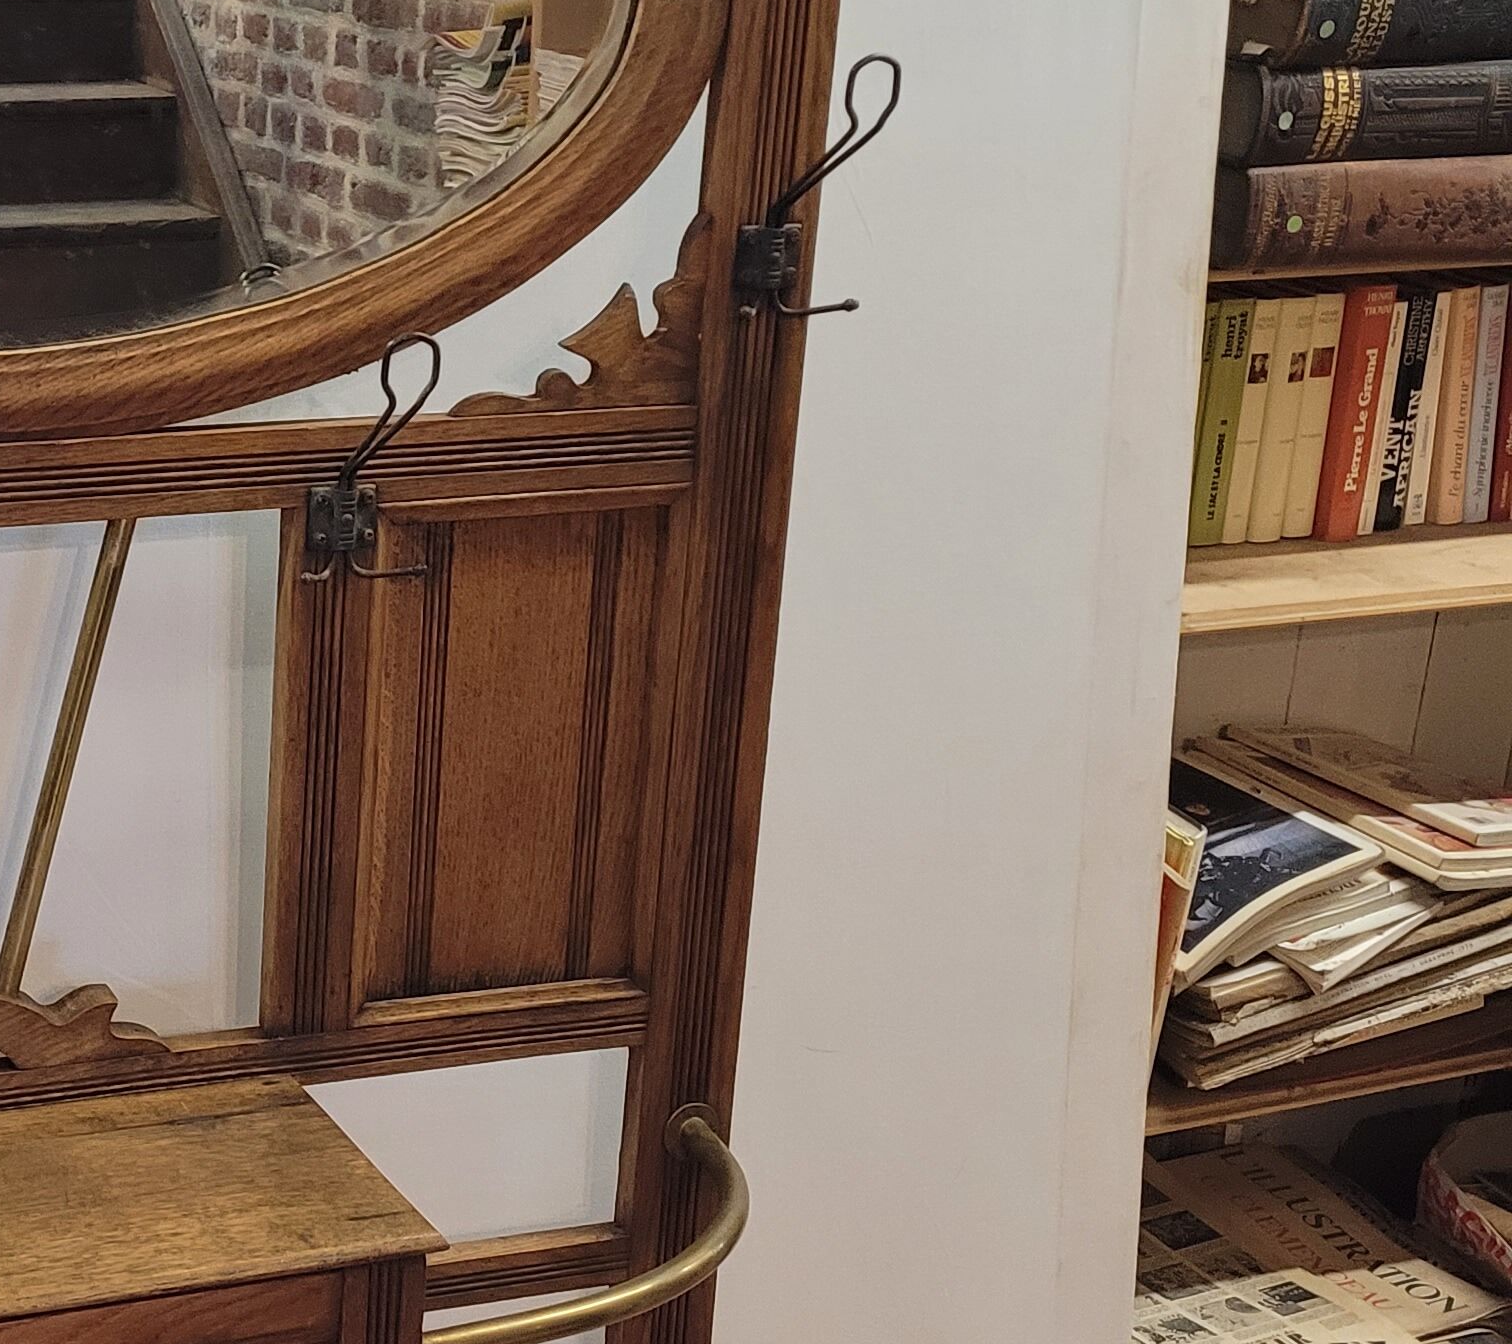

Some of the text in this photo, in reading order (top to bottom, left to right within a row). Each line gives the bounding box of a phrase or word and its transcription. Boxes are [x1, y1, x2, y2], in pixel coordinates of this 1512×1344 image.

[1221, 315, 1237, 358] henri
[1234, 311, 1248, 359] troyat
[1403, 295, 1424, 366] CHRISTINE
[1415, 299, 1434, 361] ARNOTHY
[1358, 348, 1379, 407] Grand
[1354, 410, 1368, 433] Le
[1380, 418, 1404, 481] VENT
[1394, 389, 1422, 507] AFRICAIN
[1455, 419, 1467, 439] du
[1213, 466, 1221, 478] LA
[1344, 435, 1364, 492] Pierre
